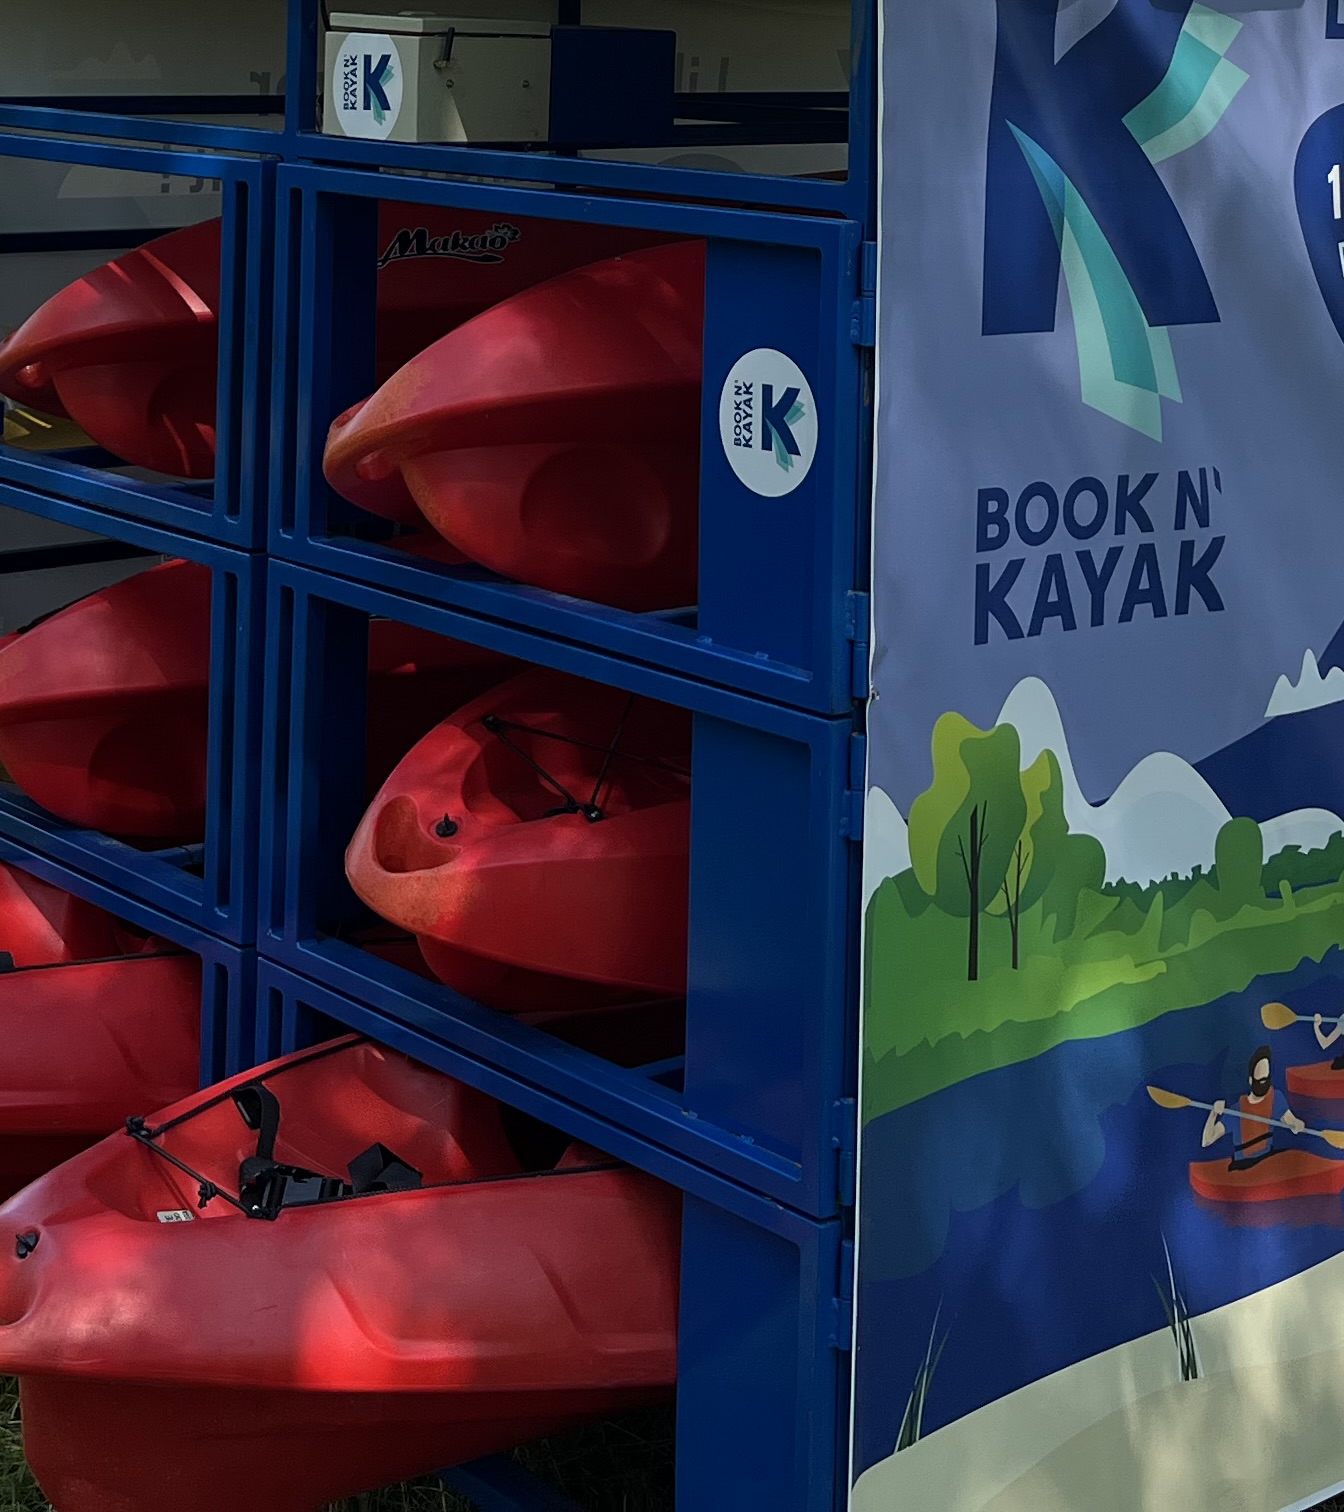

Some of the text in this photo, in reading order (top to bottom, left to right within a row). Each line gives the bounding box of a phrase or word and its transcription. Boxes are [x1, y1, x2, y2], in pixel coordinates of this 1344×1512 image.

[349, 54, 358, 111] KAYAK
[363, 54, 392, 111] K
[377, 227, 508, 270] Makao
[733, 399, 743, 447] BOOK
[742, 381, 754, 449] KAYAK
[761, 383, 802, 457] K
[975, 464, 1223, 553] BOOK N'
[973, 535, 1226, 646] KAYAK
